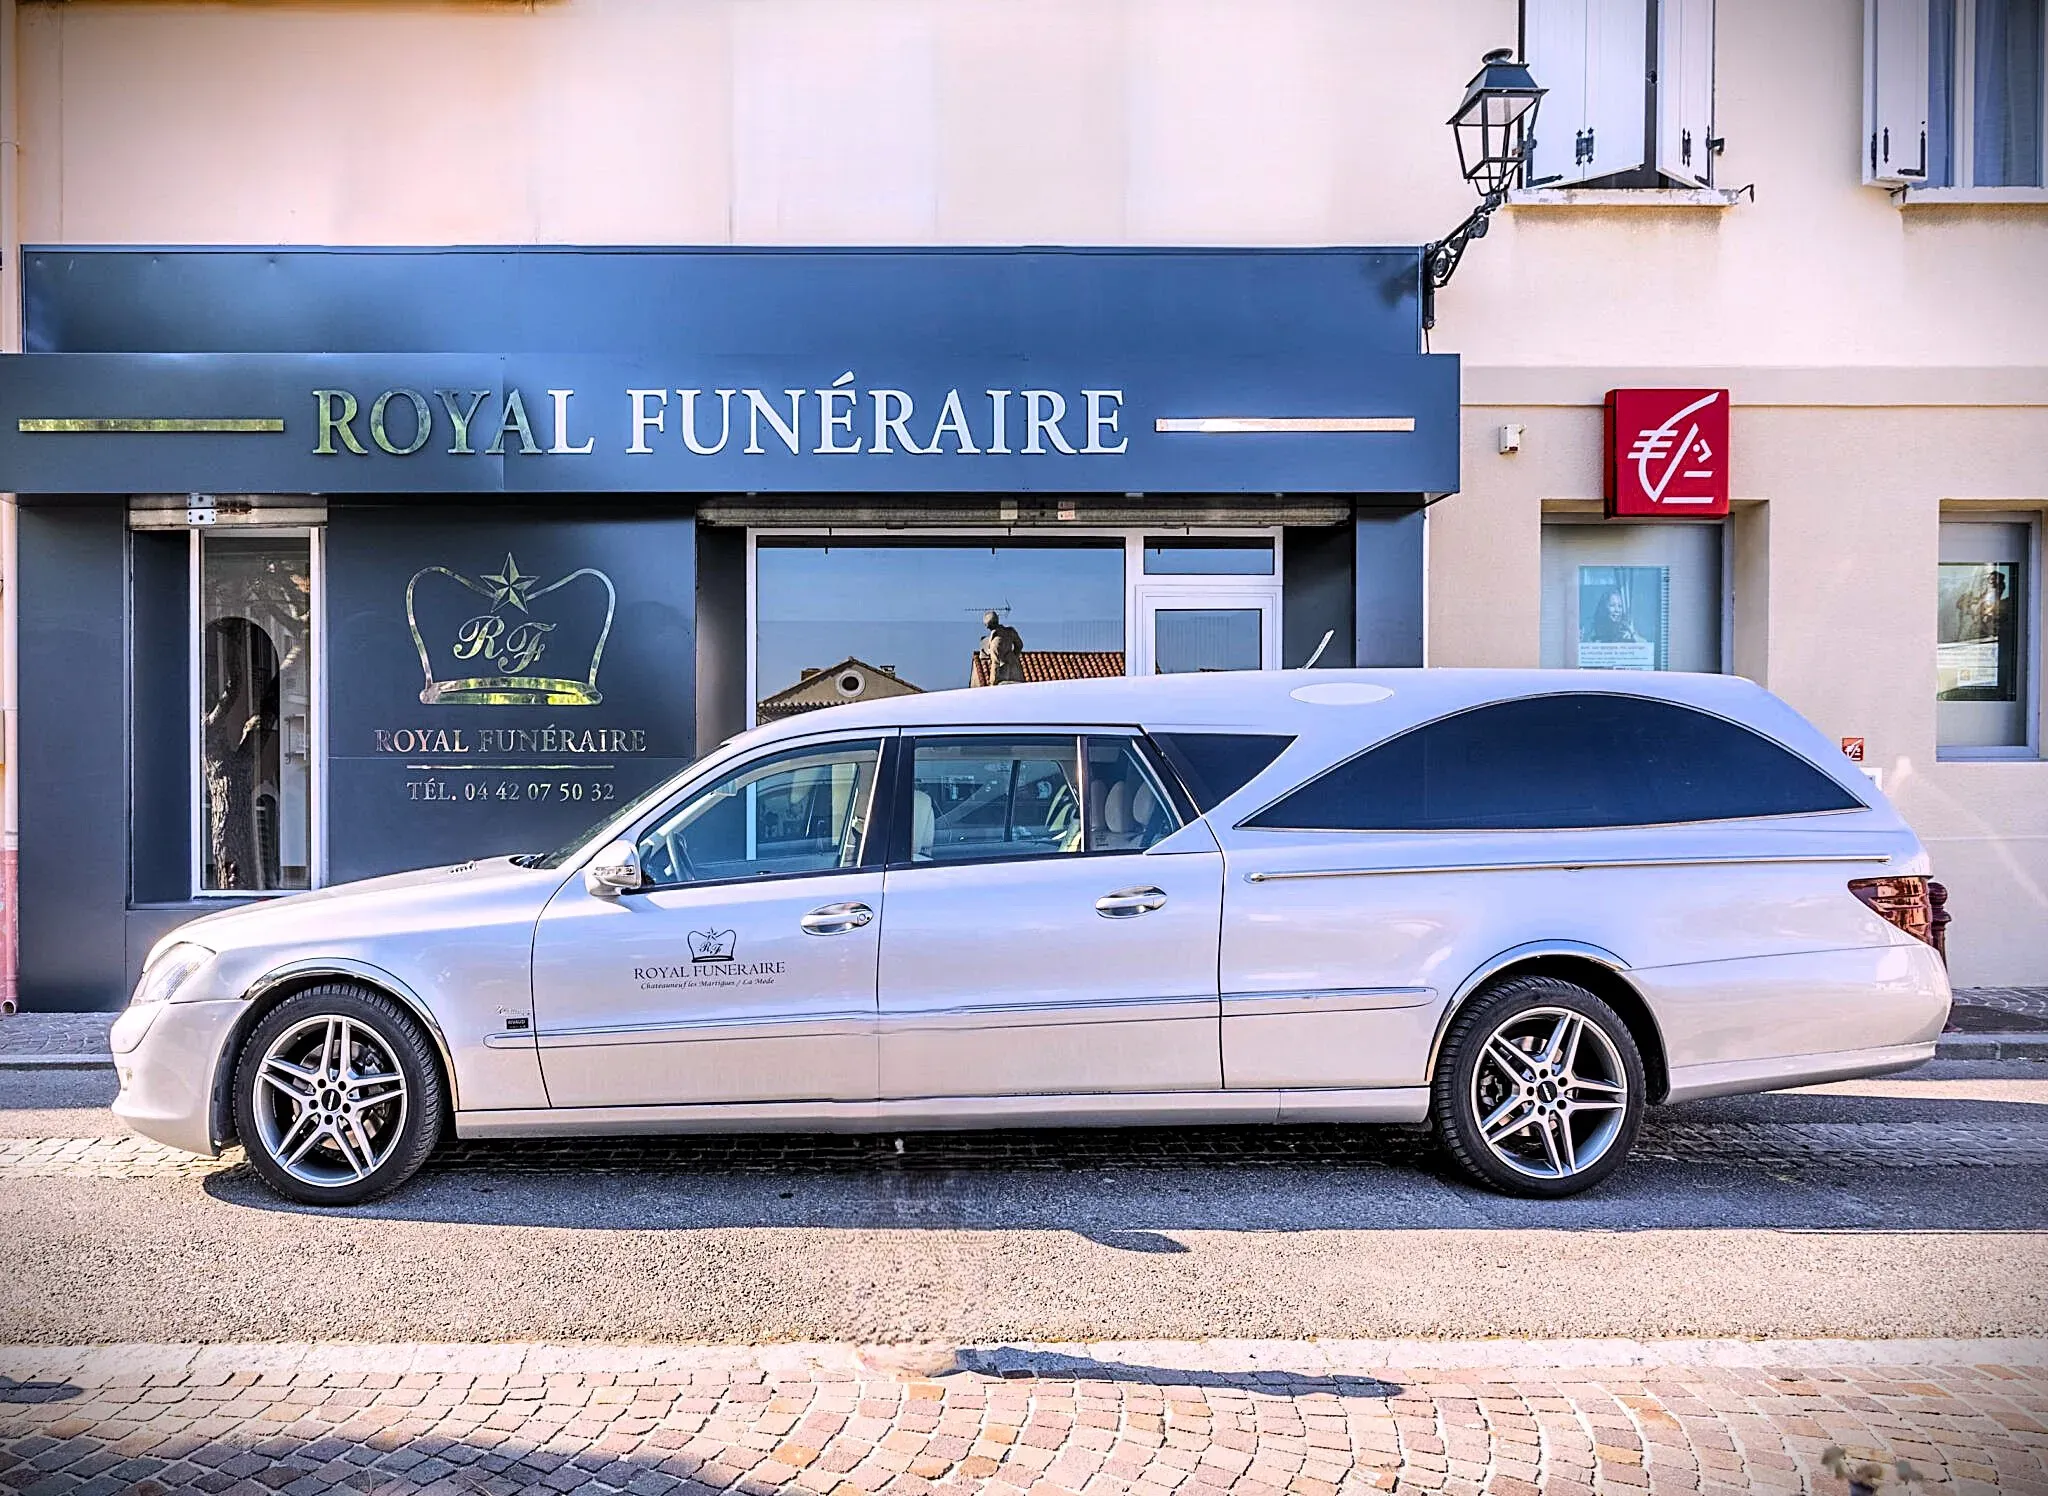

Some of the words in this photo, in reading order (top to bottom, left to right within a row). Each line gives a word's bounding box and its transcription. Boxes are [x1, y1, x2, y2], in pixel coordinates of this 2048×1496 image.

[312, 388, 595, 455] ROYAL
[625, 371, 1129, 455] FUNÉRAIRE
[374, 729, 469, 753] ROYAL
[478, 724, 647, 753] FUNÉRAIRE
[406, 778, 457, 801] TÉL.
[465, 782, 489, 801] 04
[495, 782, 520, 801] 42
[527, 782, 552, 801] 07
[558, 782, 583, 801] 50
[590, 782, 616, 801] 32
[635, 966, 689, 979] ROYAL
